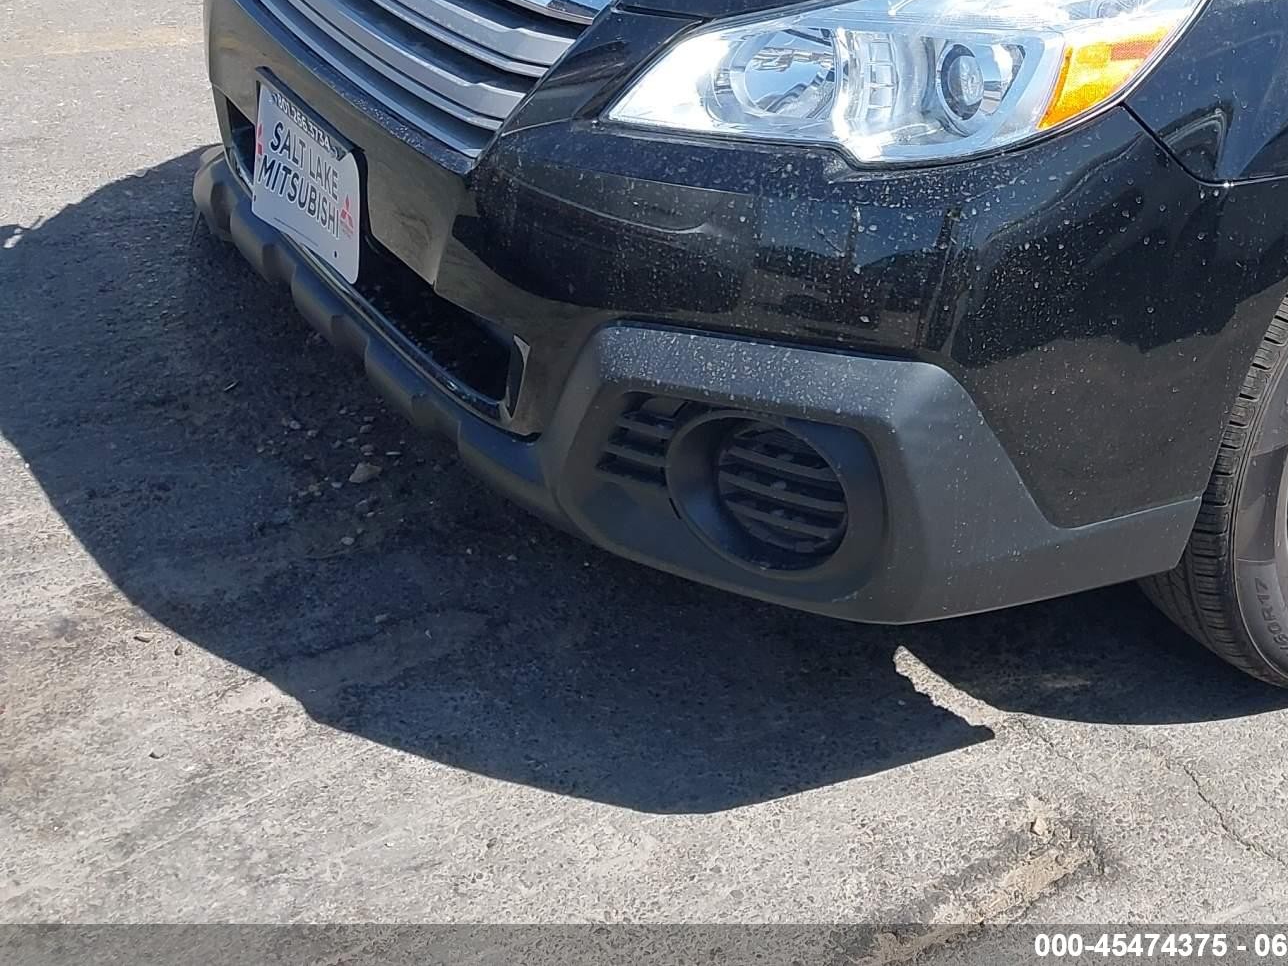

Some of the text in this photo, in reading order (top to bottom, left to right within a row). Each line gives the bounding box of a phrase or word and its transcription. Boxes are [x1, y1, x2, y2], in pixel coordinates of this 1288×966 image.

[258, 155, 339, 239] MITSUBISHI
[270, 121, 338, 200] SALT LAKE
